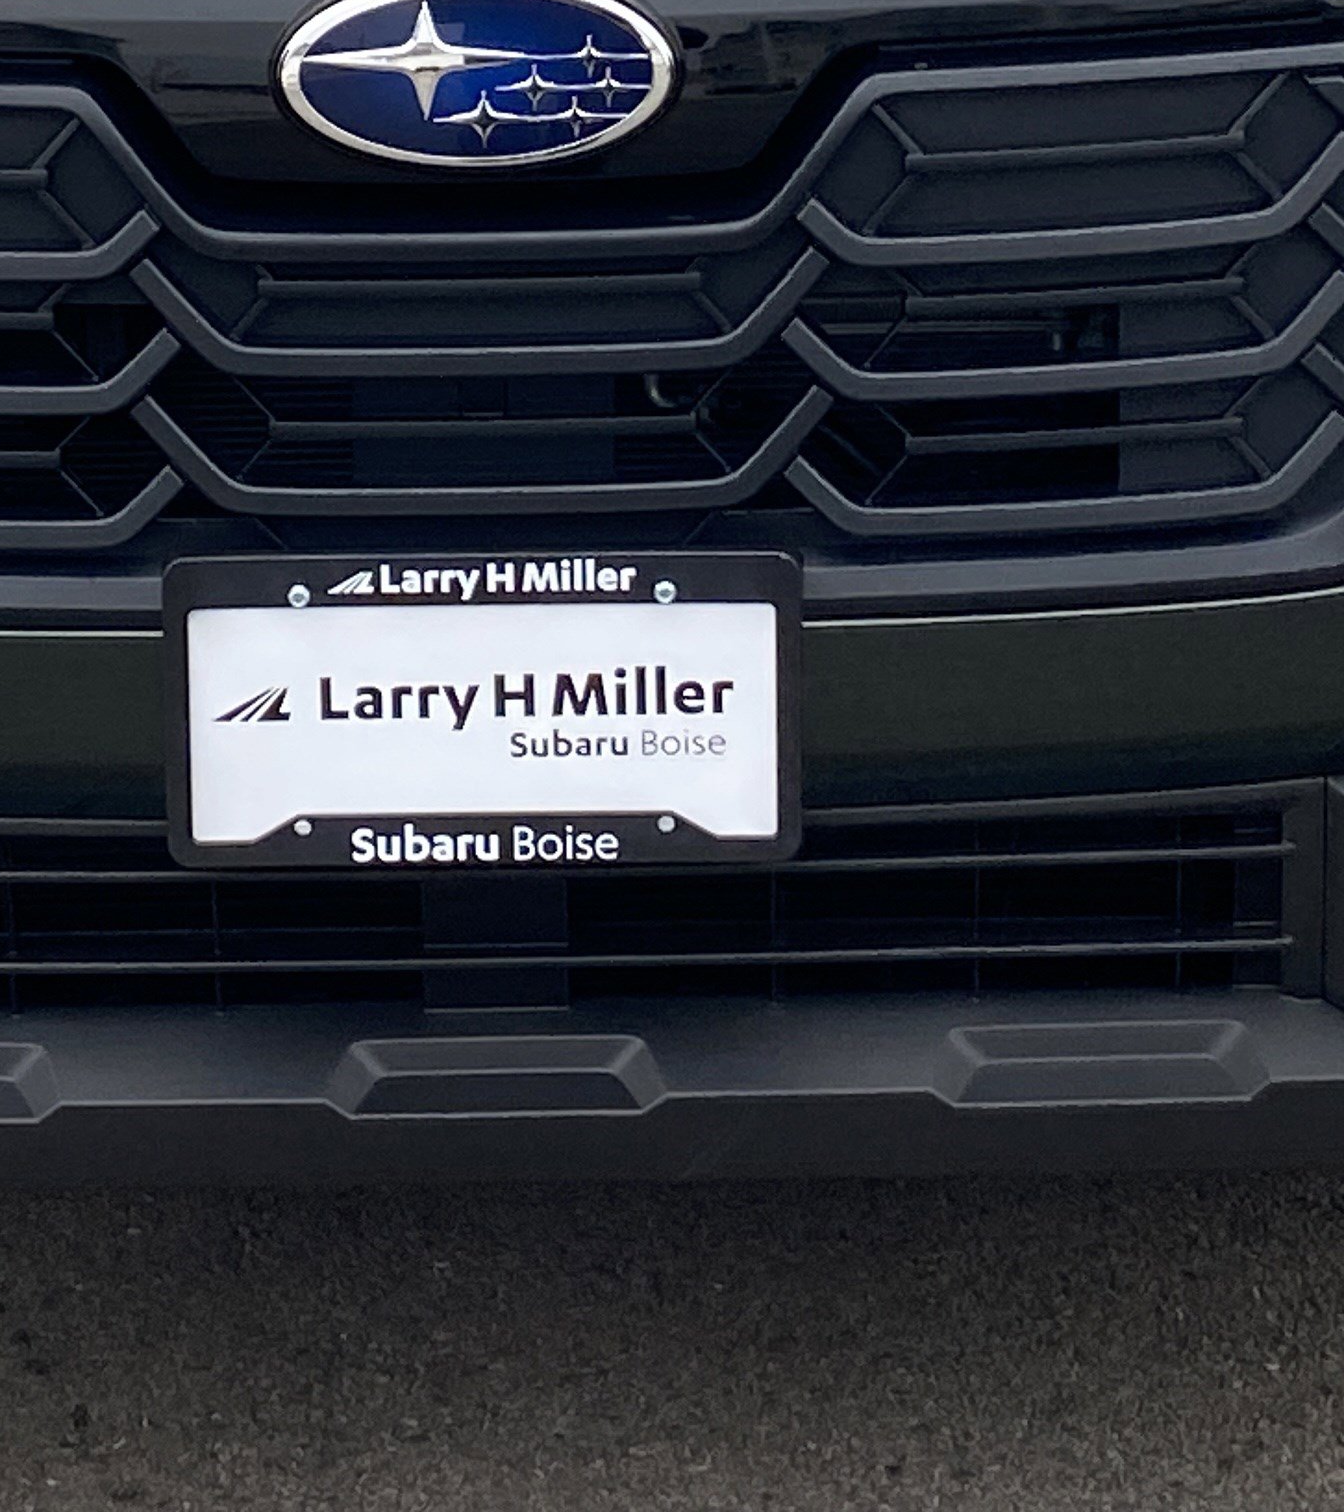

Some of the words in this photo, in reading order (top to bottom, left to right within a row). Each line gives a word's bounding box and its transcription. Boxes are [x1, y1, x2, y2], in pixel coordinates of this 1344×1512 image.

[380, 563, 480, 601] Larry
[486, 563, 515, 593] H
[522, 559, 637, 593] Miller
[319, 676, 479, 731] Larry
[494, 674, 535, 718] H
[553, 666, 734, 717] Miller
[509, 730, 629, 758] Subaru
[641, 730, 727, 757] Boise
[351, 825, 500, 863] Subaru
[512, 826, 620, 863] Boise
